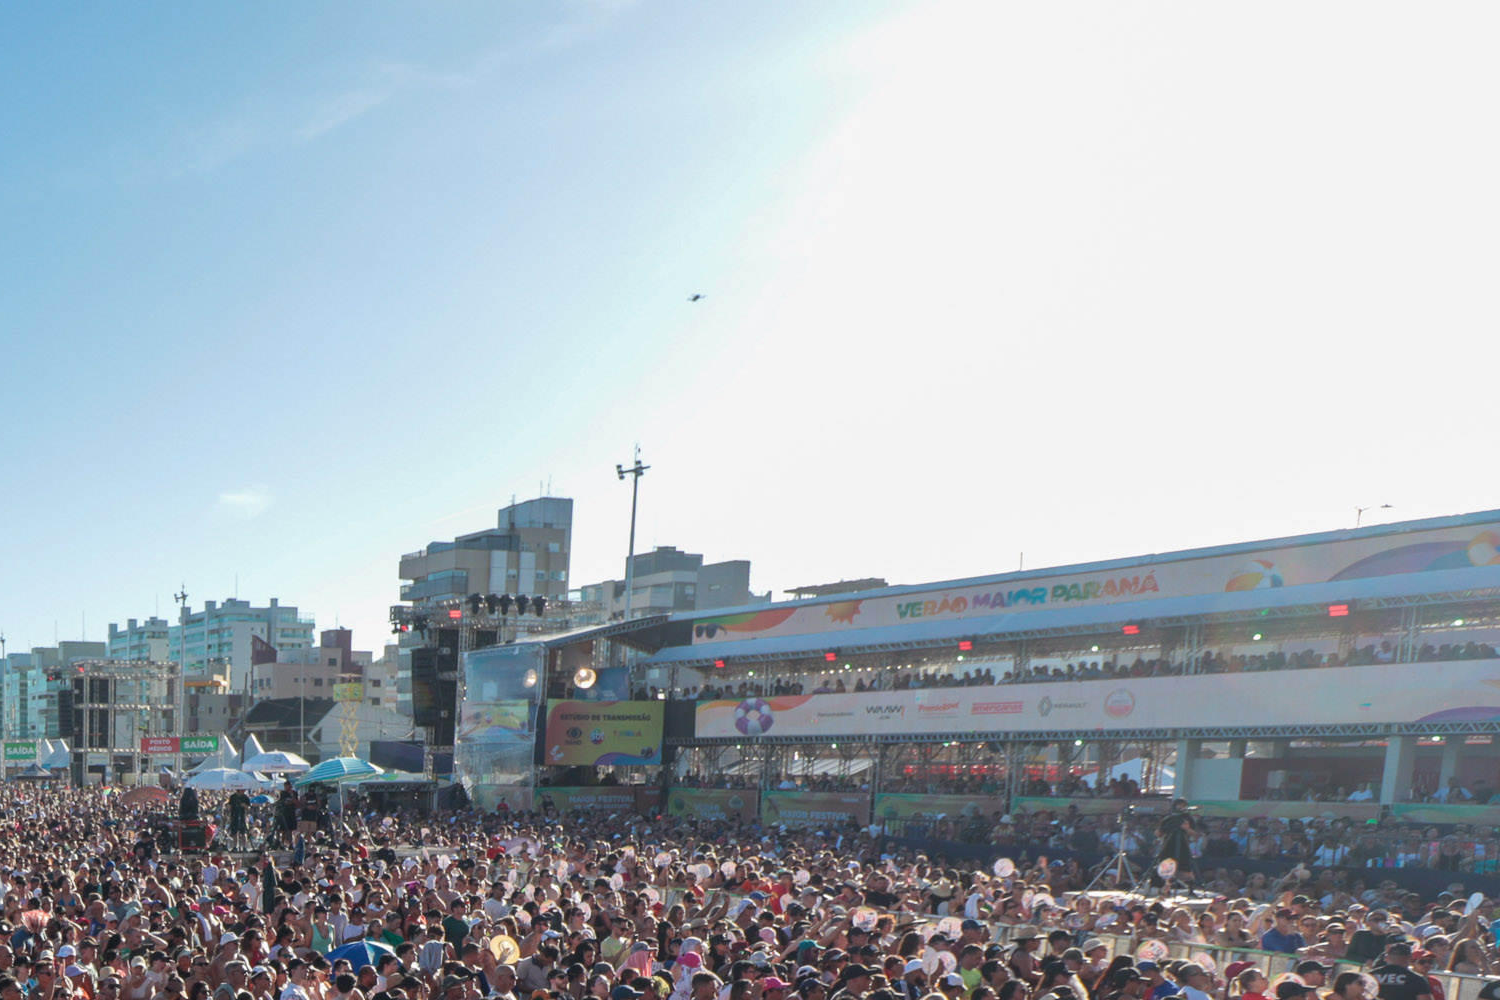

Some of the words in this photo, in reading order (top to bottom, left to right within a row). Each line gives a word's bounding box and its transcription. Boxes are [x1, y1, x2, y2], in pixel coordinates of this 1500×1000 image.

[896, 594, 968, 619] VERÃO
[971, 586, 1048, 610] MAIOR
[1050, 570, 1159, 603] PARANÁ
[603, 713, 651, 721] TRANSMISSÃO
[183, 739, 214, 749] SAÍDA
[6, 745, 34, 755] SAÍDA
